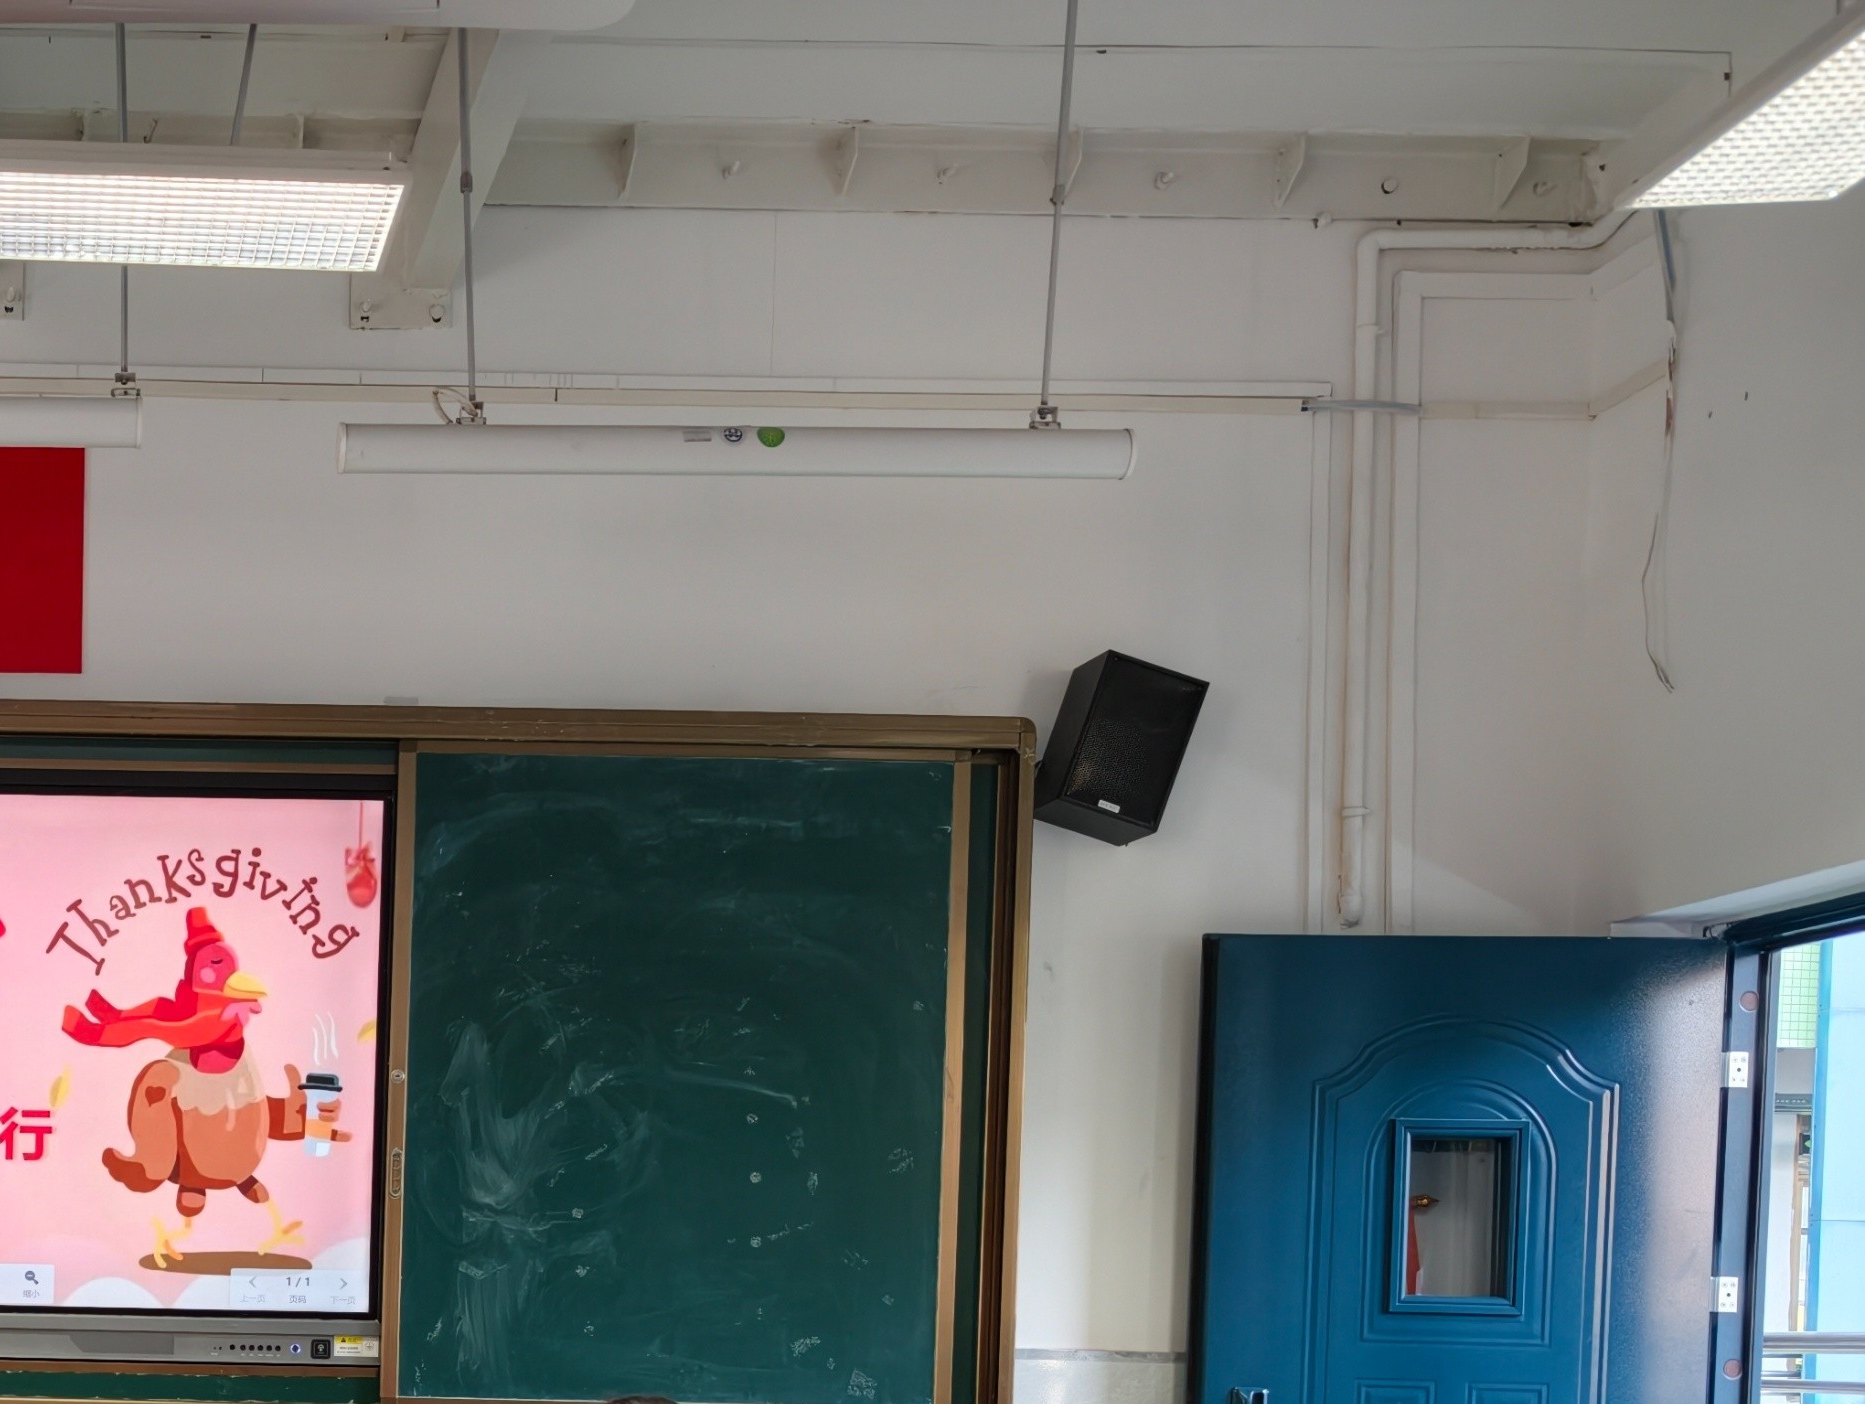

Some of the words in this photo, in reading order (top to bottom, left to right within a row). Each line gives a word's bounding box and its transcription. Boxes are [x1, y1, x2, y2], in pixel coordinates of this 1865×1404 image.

[45, 847, 360, 976] Thanksgiving
[22, 1289, 40, 1299] 缩小
[289, 1294, 307, 1304] 页码
